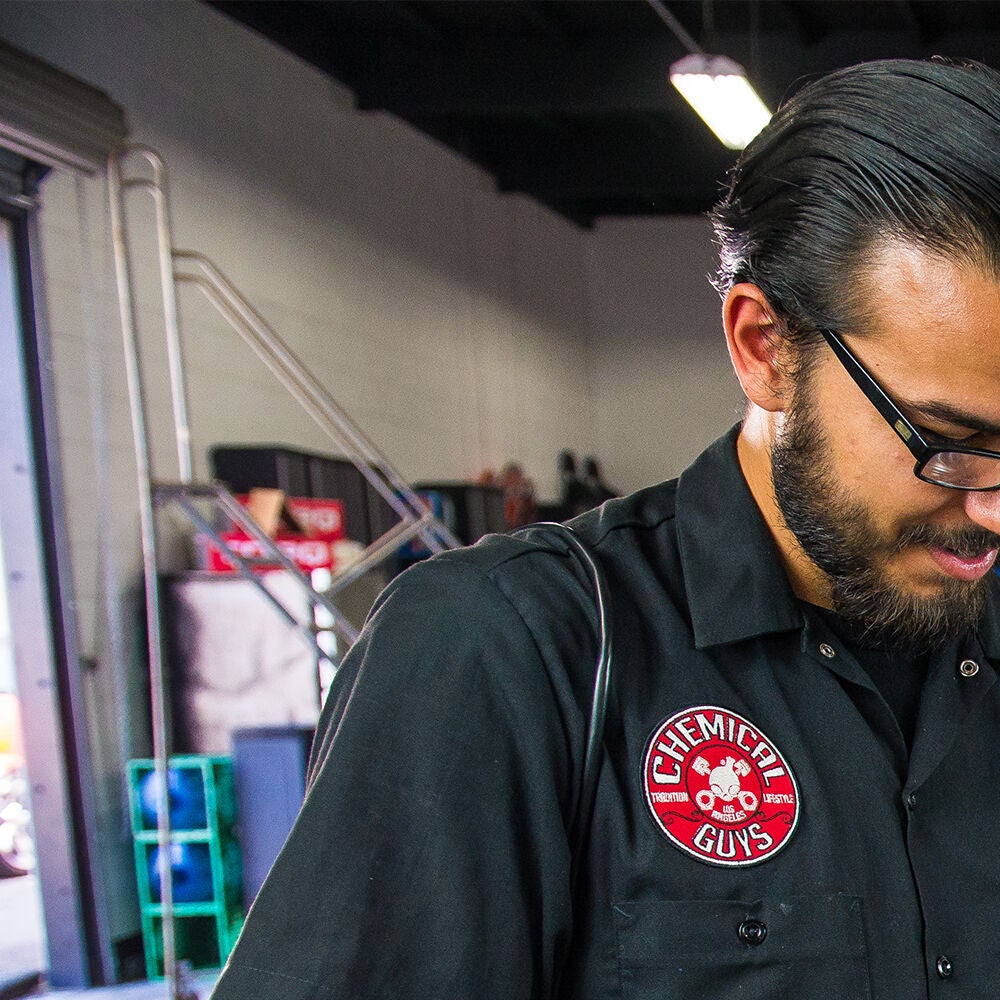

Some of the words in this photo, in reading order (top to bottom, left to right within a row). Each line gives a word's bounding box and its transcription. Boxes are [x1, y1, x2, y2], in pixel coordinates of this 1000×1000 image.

[653, 713, 786, 787] CHEMICAL
[762, 792, 794, 804] LIFESTYLE
[692, 823, 774, 858] GUYS
